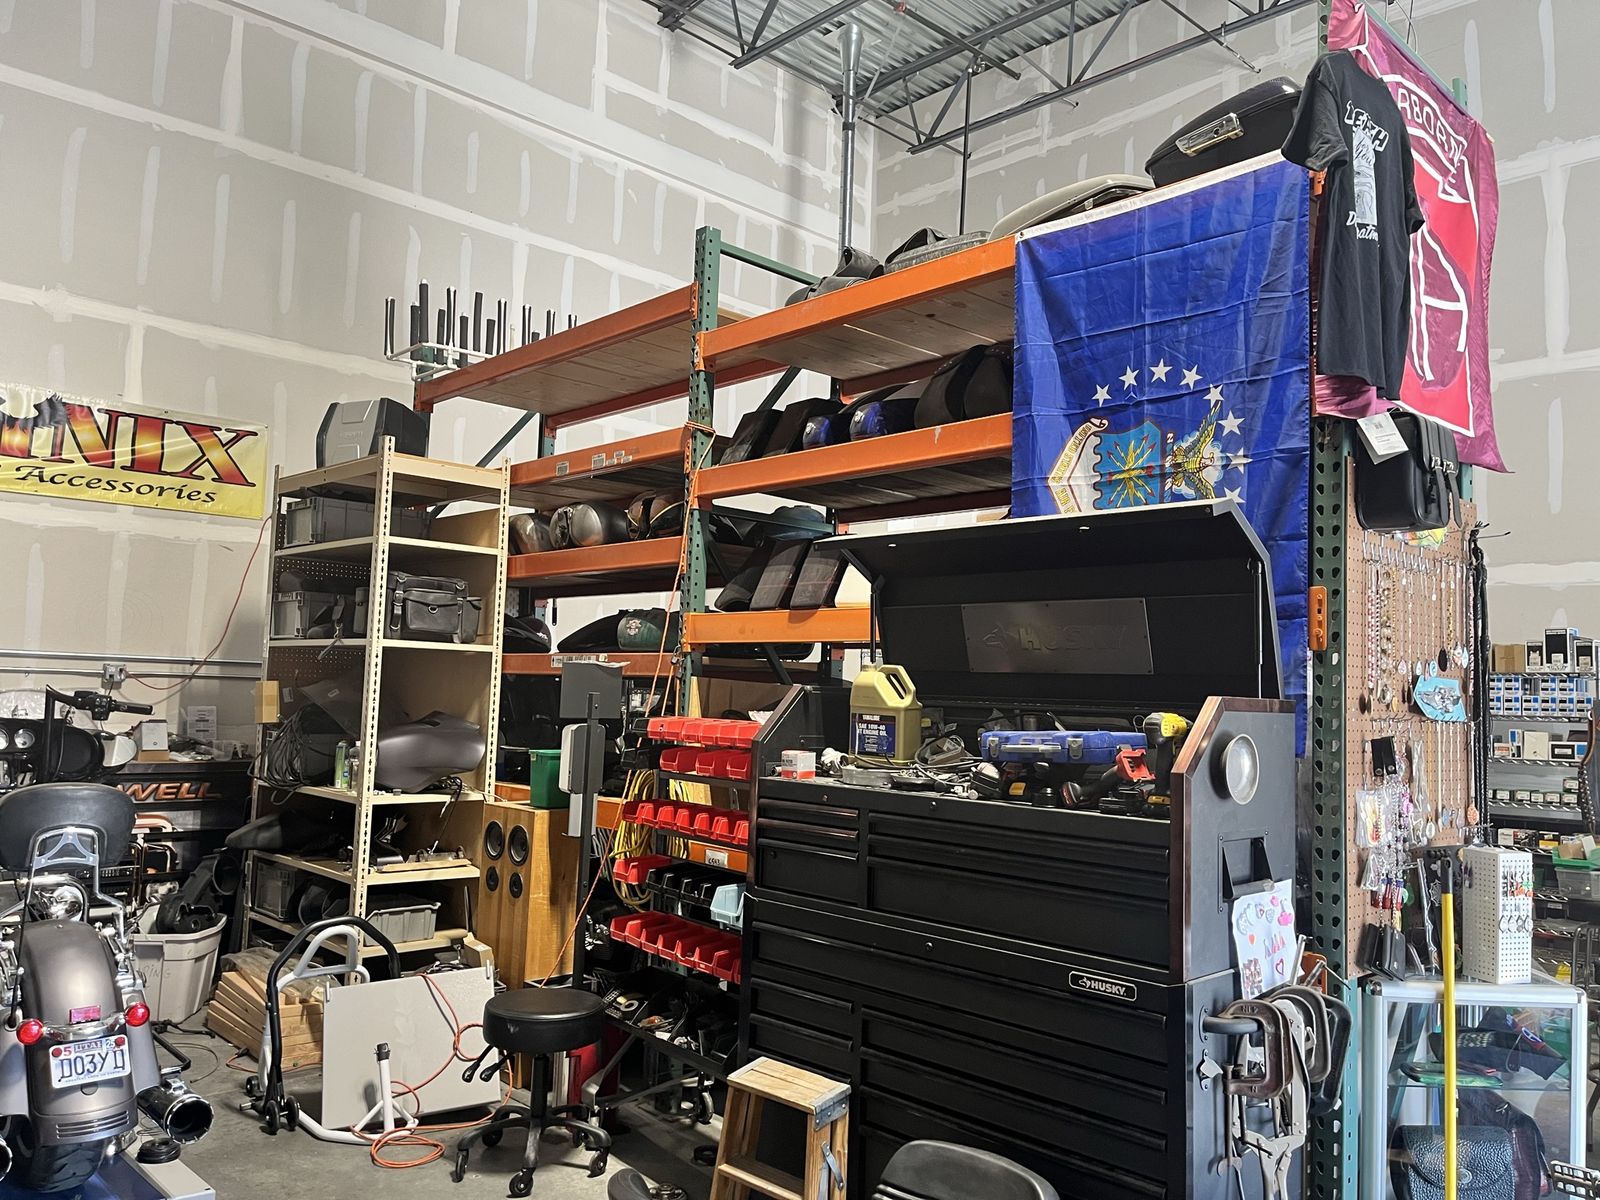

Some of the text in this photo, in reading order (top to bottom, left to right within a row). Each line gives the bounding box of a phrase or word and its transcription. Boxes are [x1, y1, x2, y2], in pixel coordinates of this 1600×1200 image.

[15, 465, 217, 503] Accessories
[117, 782, 222, 801] WELL
[1091, 980, 1127, 996] HUSKY
[63, 1046, 72, 1056] 5
